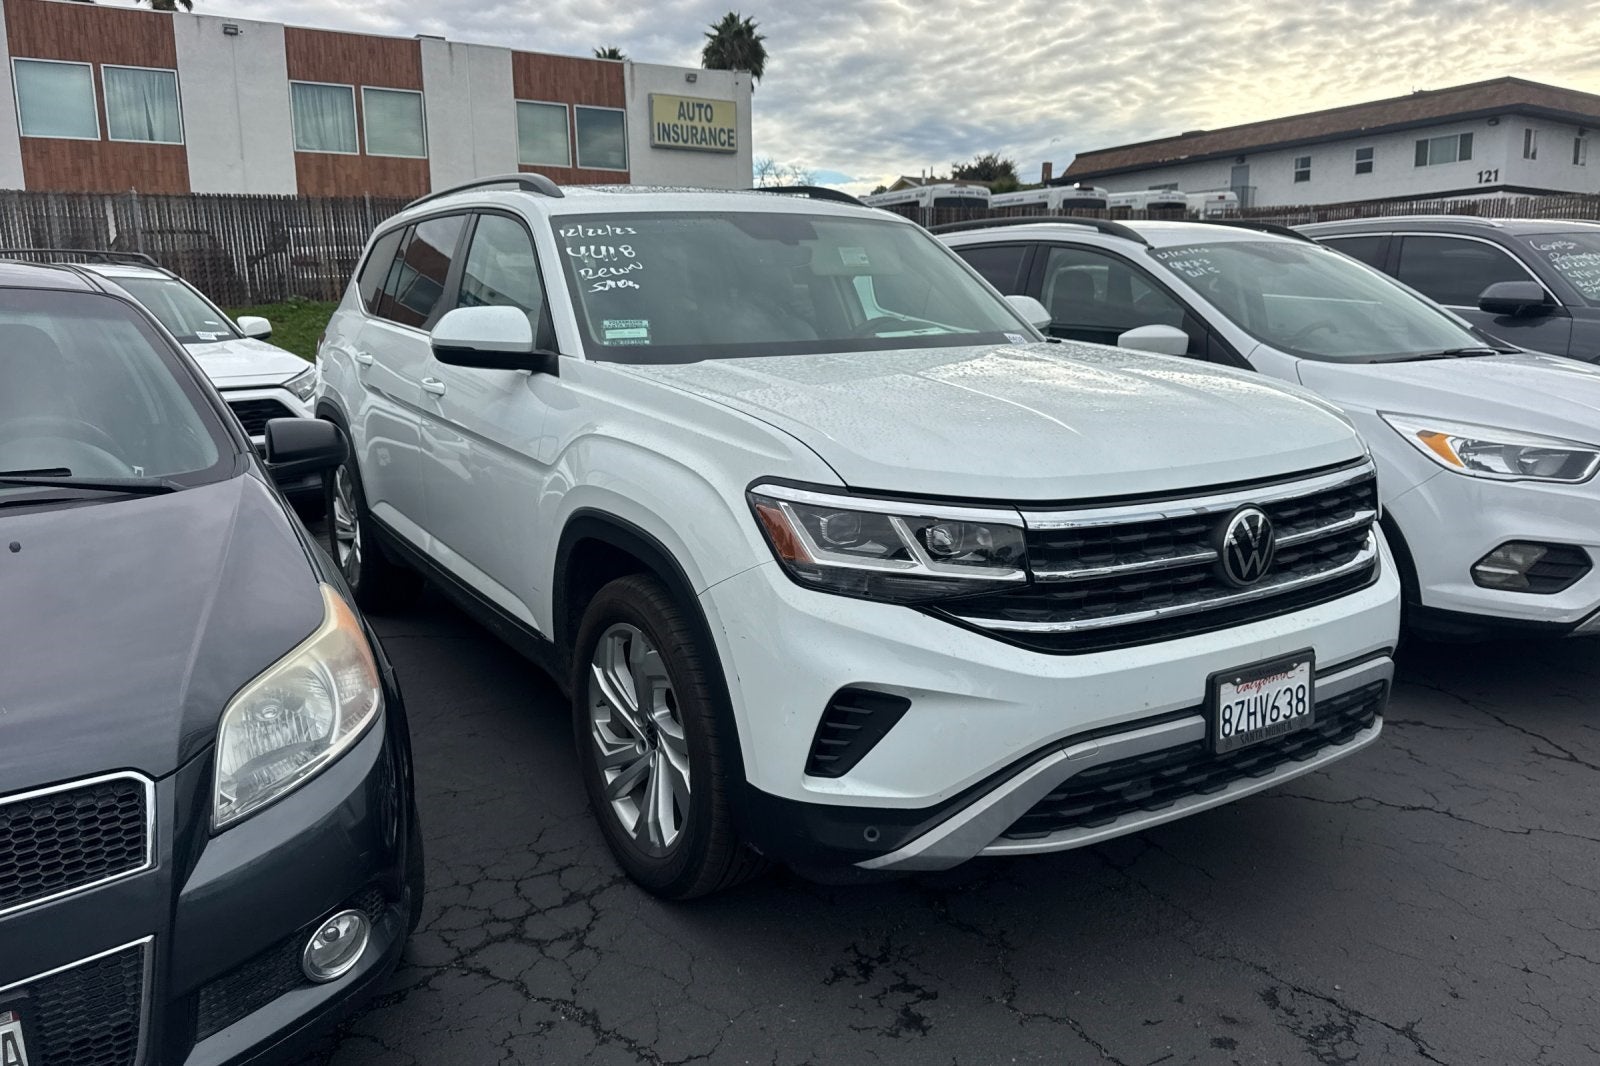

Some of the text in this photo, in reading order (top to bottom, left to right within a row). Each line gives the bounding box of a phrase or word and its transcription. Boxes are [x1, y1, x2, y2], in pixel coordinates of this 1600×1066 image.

[678, 101, 713, 123] AUTO
[657, 122, 735, 148] INSURANCE
[1477, 168, 1500, 184] 121
[1221, 683, 1306, 738] 8ZHV638
